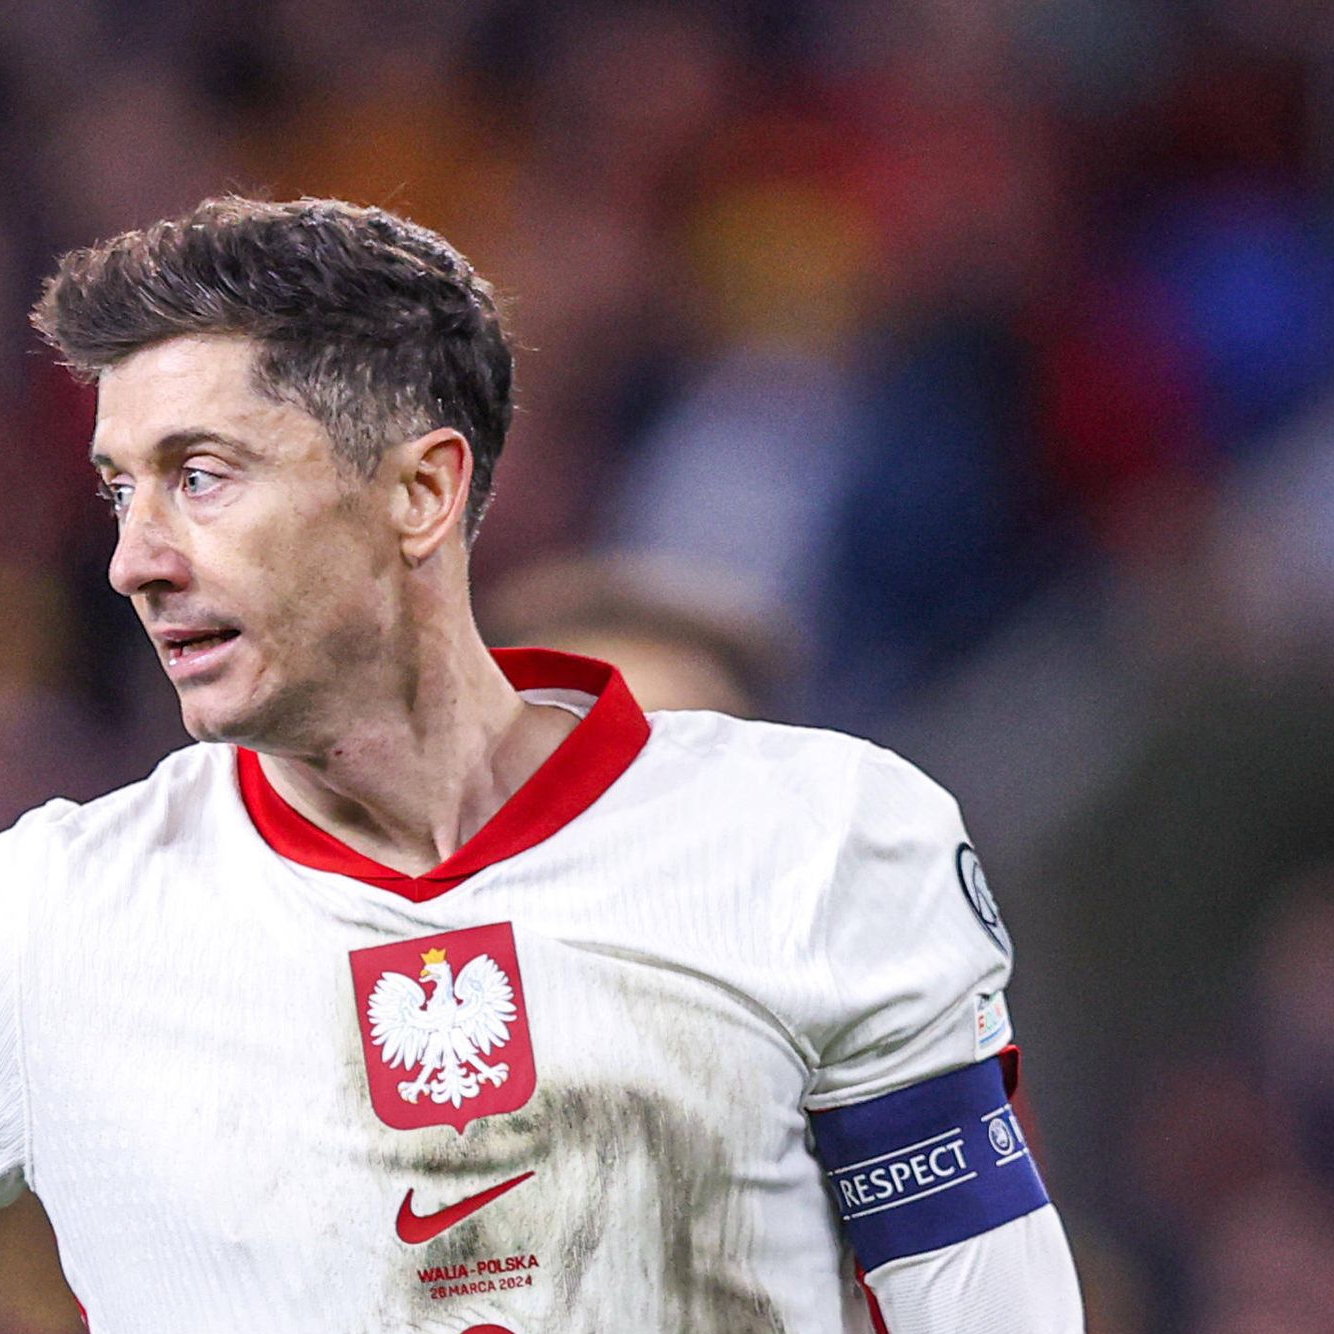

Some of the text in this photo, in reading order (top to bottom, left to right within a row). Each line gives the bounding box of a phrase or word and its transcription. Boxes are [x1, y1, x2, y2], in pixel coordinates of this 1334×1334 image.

[839, 1139, 968, 1208] RESPECT
[448, 1281, 496, 1297] MARCA
[498, 1275, 533, 1290] 2024
